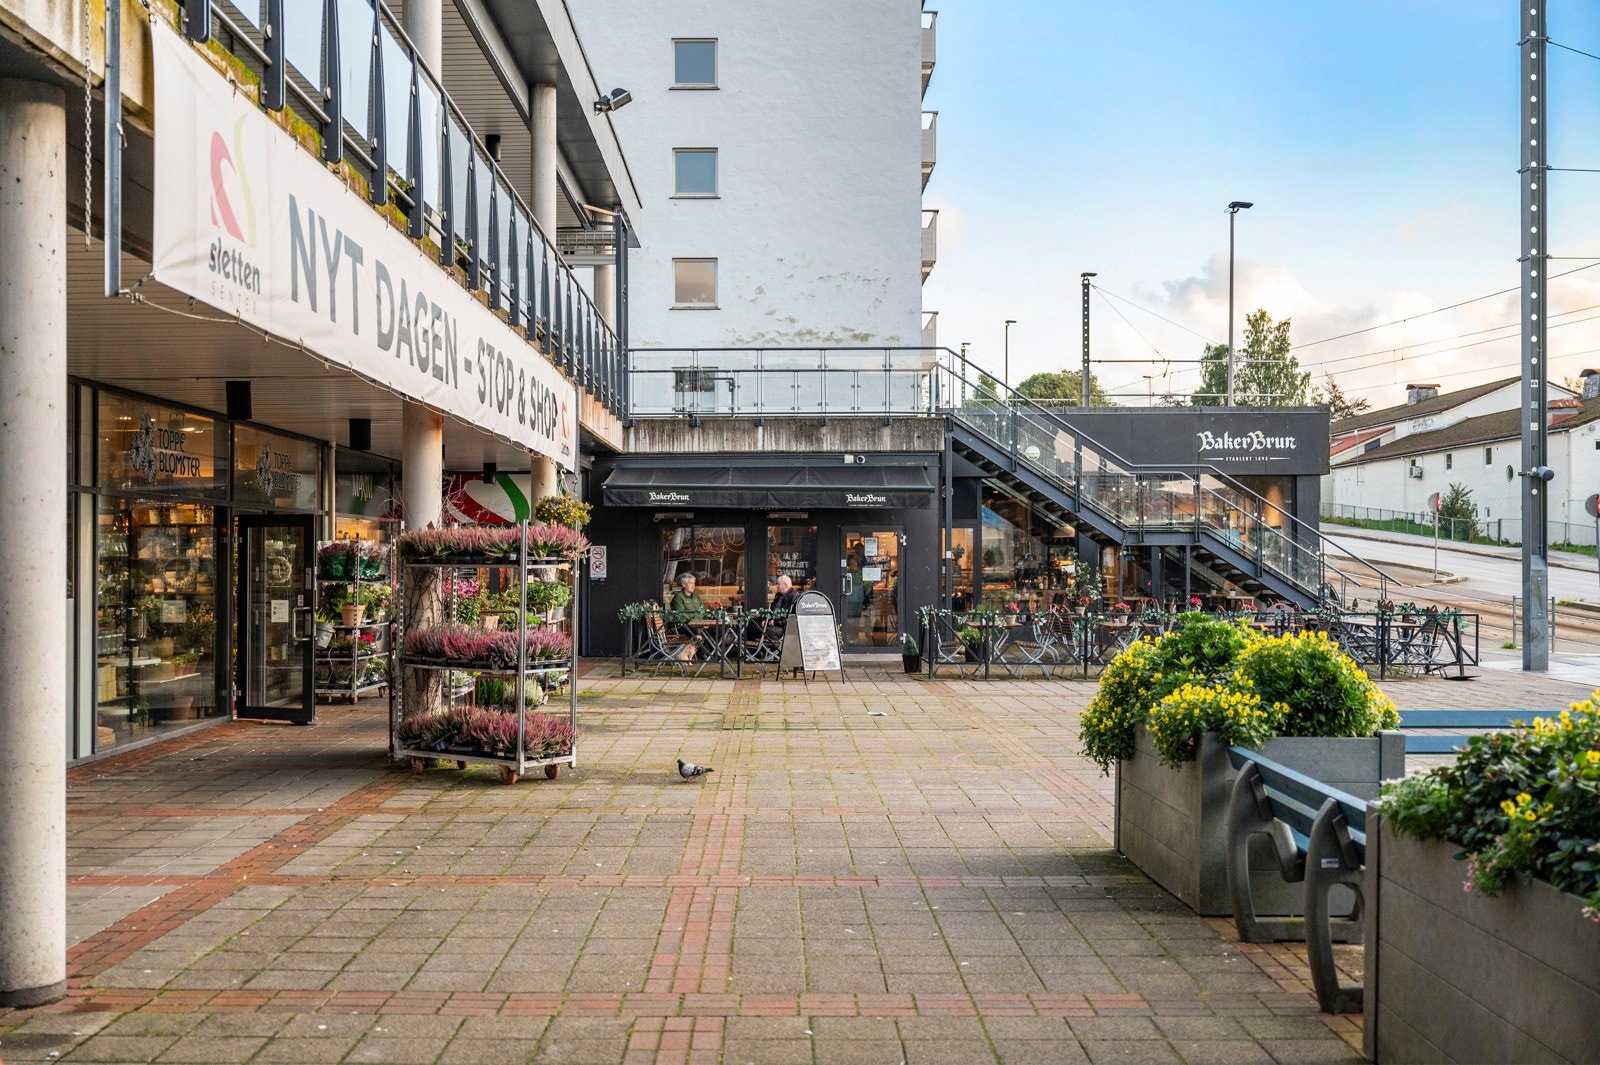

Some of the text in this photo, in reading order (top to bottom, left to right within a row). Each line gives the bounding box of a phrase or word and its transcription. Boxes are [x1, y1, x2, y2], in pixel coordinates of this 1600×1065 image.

[208, 236, 260, 295] sletten
[211, 280, 257, 315] SENTER
[288, 193, 364, 336] NYT
[375, 259, 458, 390] DAGEN
[477, 337, 515, 417] STOP
[517, 367, 526, 426] &
[530, 376, 558, 442] SHOP
[157, 428, 187, 452] TOPPE
[1196, 430, 1297, 453] BakerBrun
[159, 452, 201, 478] BLOMSTER
[273, 452, 293, 472] TOPPE
[649, 491, 690, 501] BakerBrun
[846, 493, 887, 503] BakerBrun
